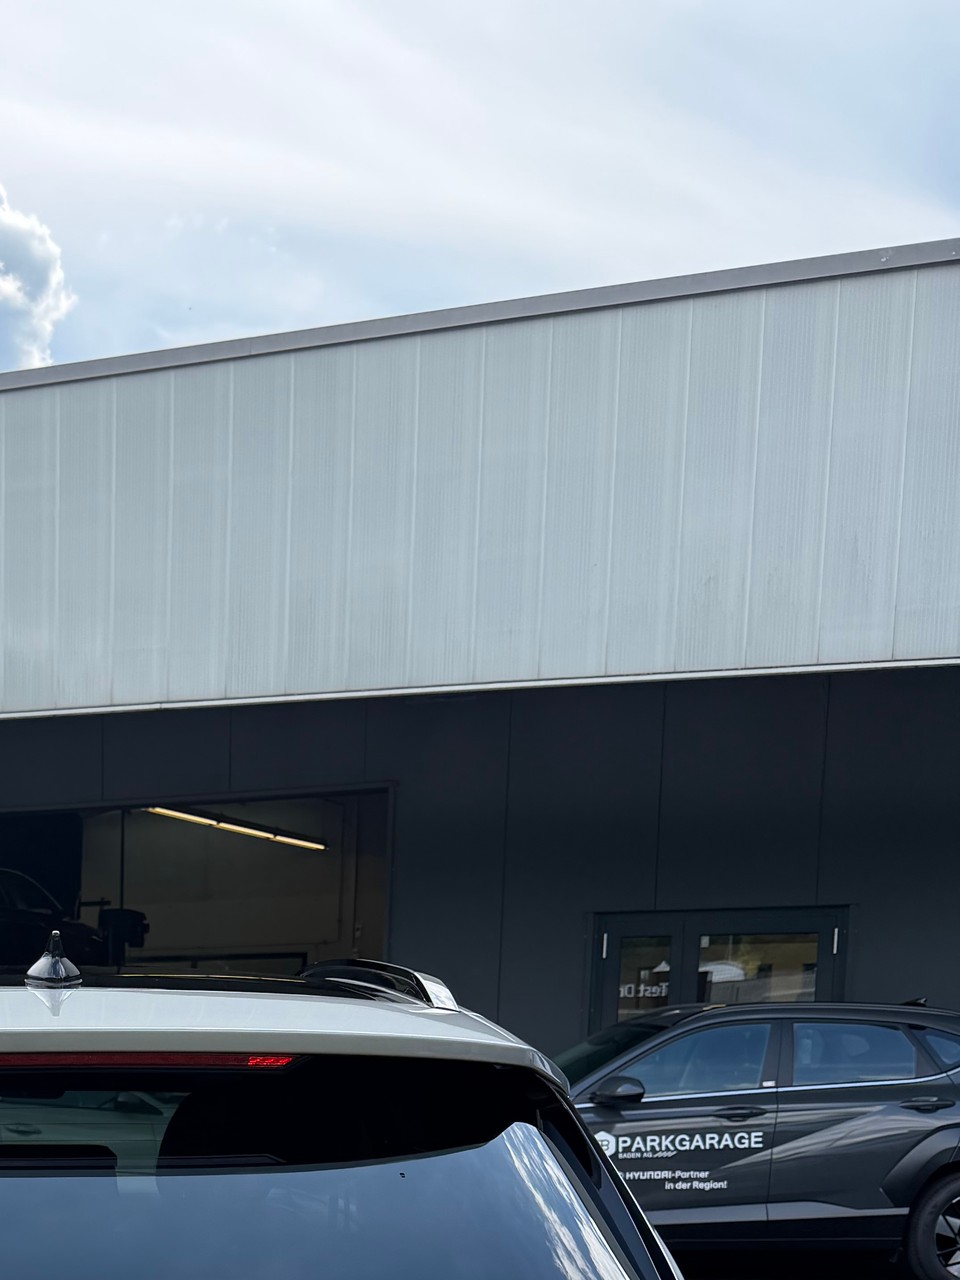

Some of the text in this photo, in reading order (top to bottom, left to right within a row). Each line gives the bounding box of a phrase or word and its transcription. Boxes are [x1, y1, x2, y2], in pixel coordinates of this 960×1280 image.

[618, 1132, 763, 1152] PARKGARAGE
[625, 1171, 709, 1180] HYUNDAI-Partner
[665, 1180, 728, 1191] in der Region!
